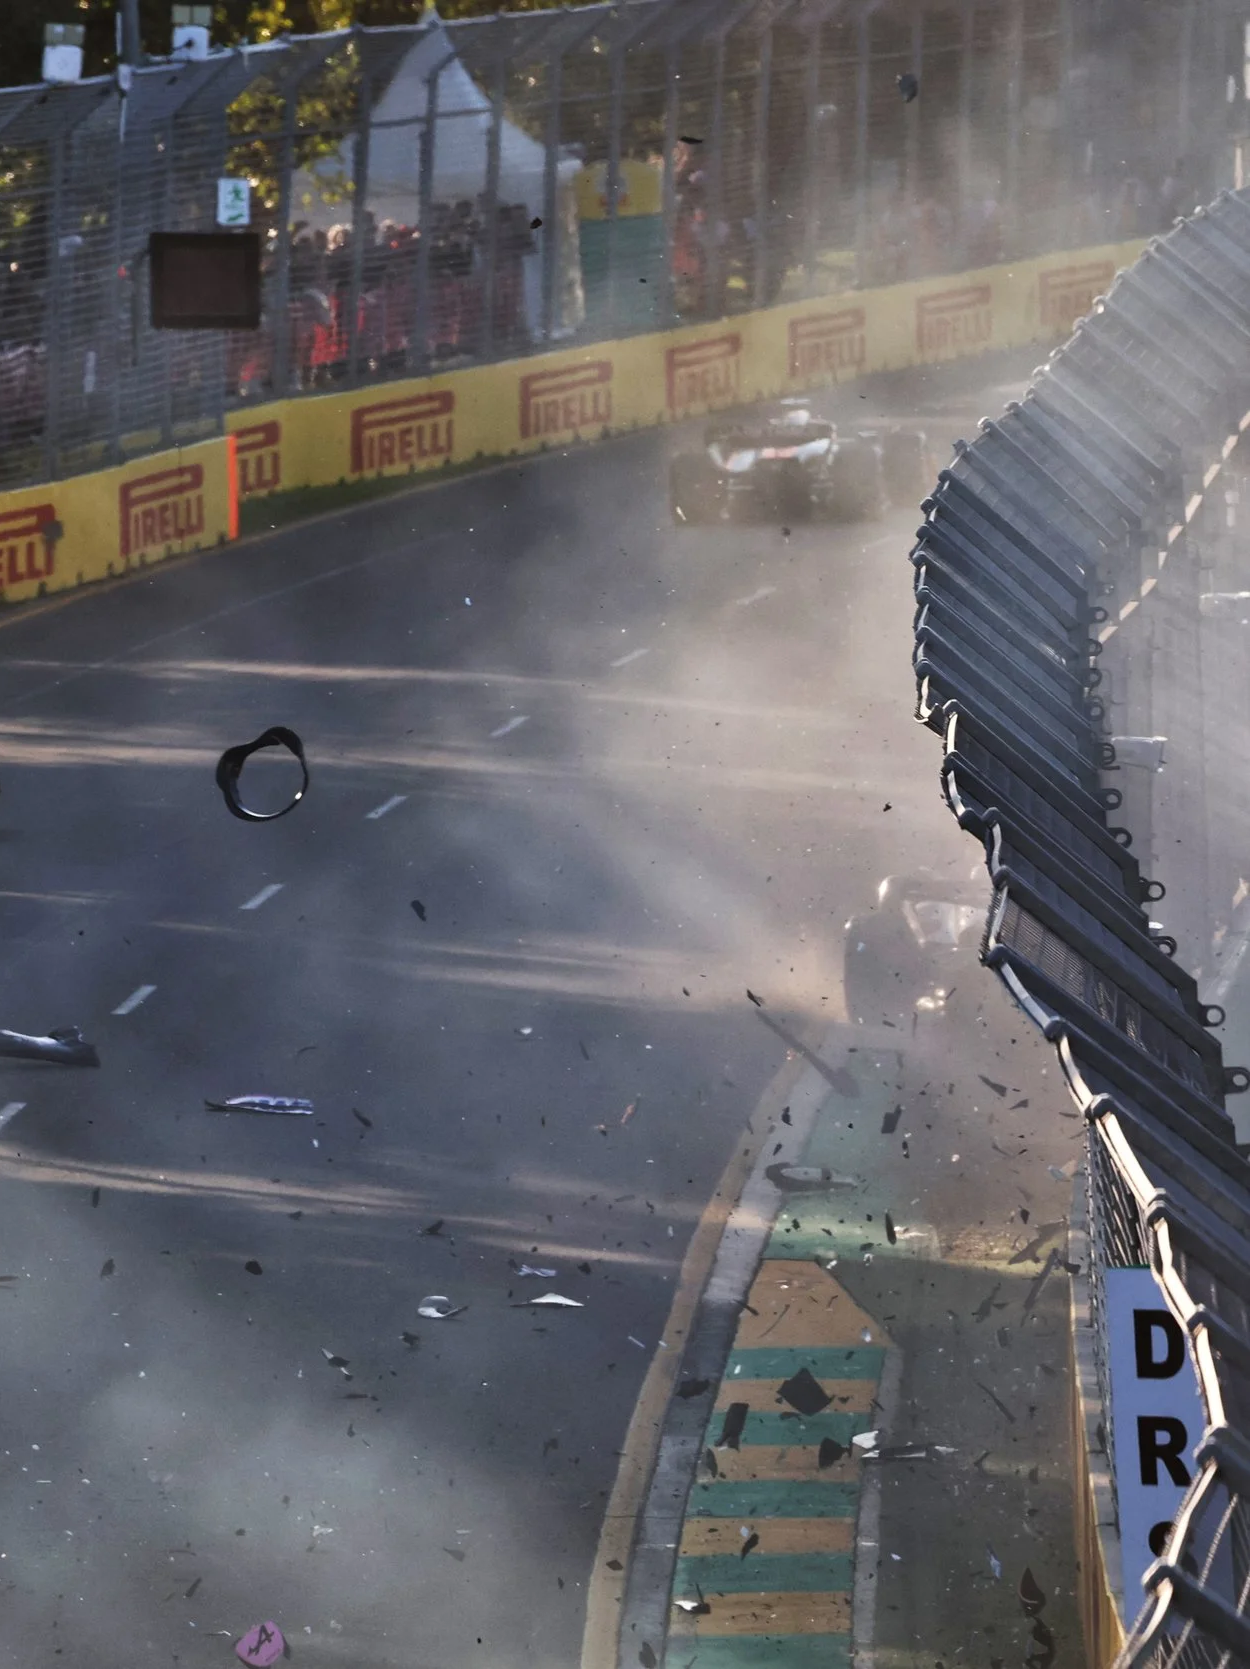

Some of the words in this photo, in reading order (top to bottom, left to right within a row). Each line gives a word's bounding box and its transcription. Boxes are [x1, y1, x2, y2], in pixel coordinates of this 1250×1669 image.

[352, 390, 454, 473] PIRELLI
[520, 360, 613, 439] PIRELLI
[119, 464, 204, 558] PIRELLI
